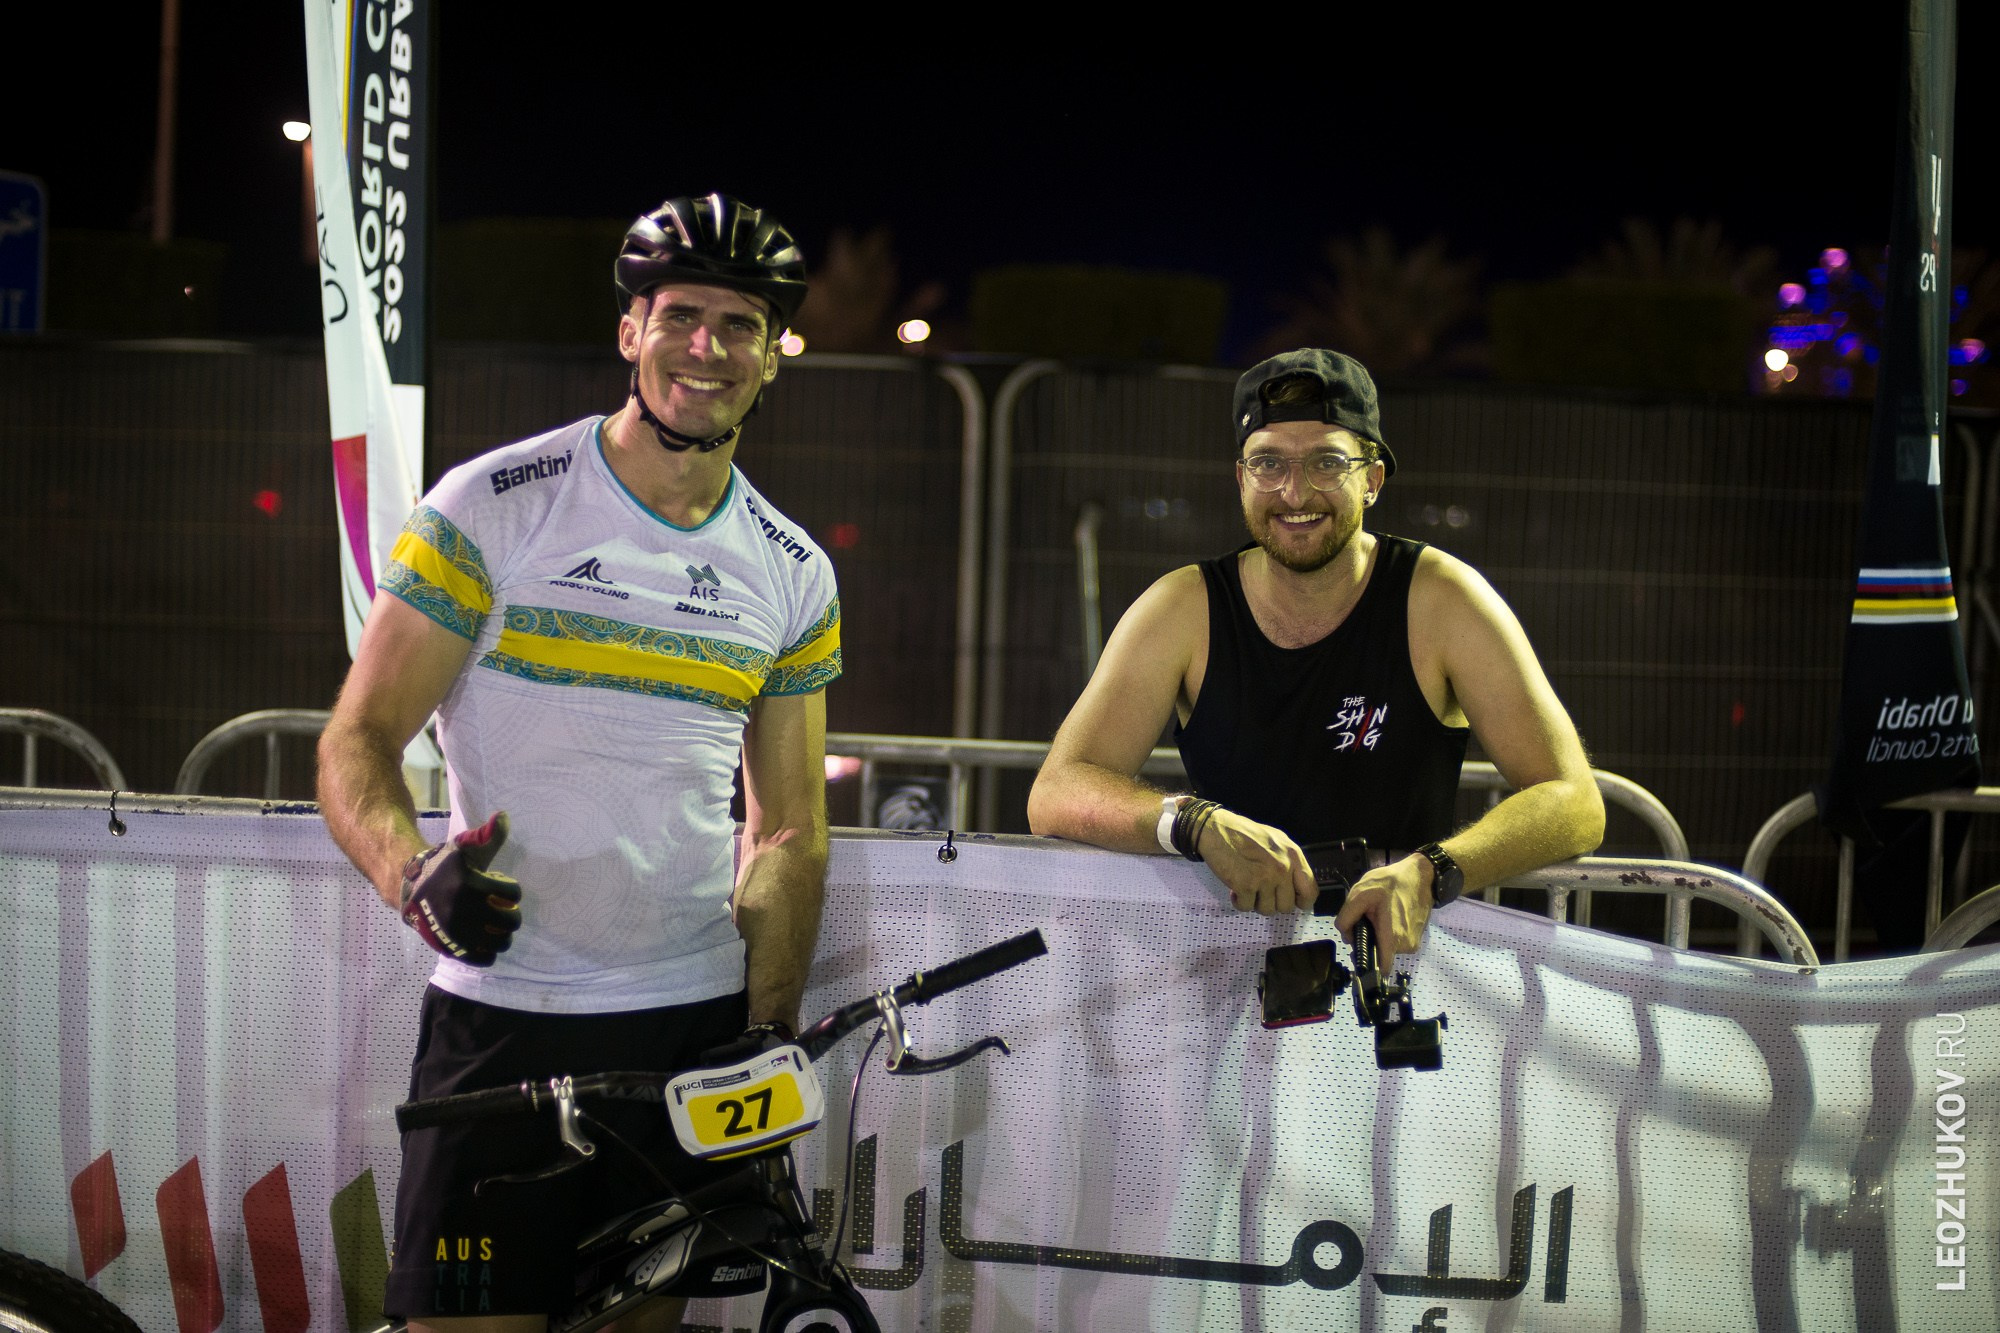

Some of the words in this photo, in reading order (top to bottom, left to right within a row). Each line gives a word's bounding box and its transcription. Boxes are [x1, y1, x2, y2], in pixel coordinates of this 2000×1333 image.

[489, 450, 573, 496] Santini
[689, 586, 719, 601] AIS
[1342, 696, 1365, 707] THE
[716, 1087, 772, 1137] 27
[436, 1237, 492, 1261] AUS
[711, 1263, 764, 1282] Santini
